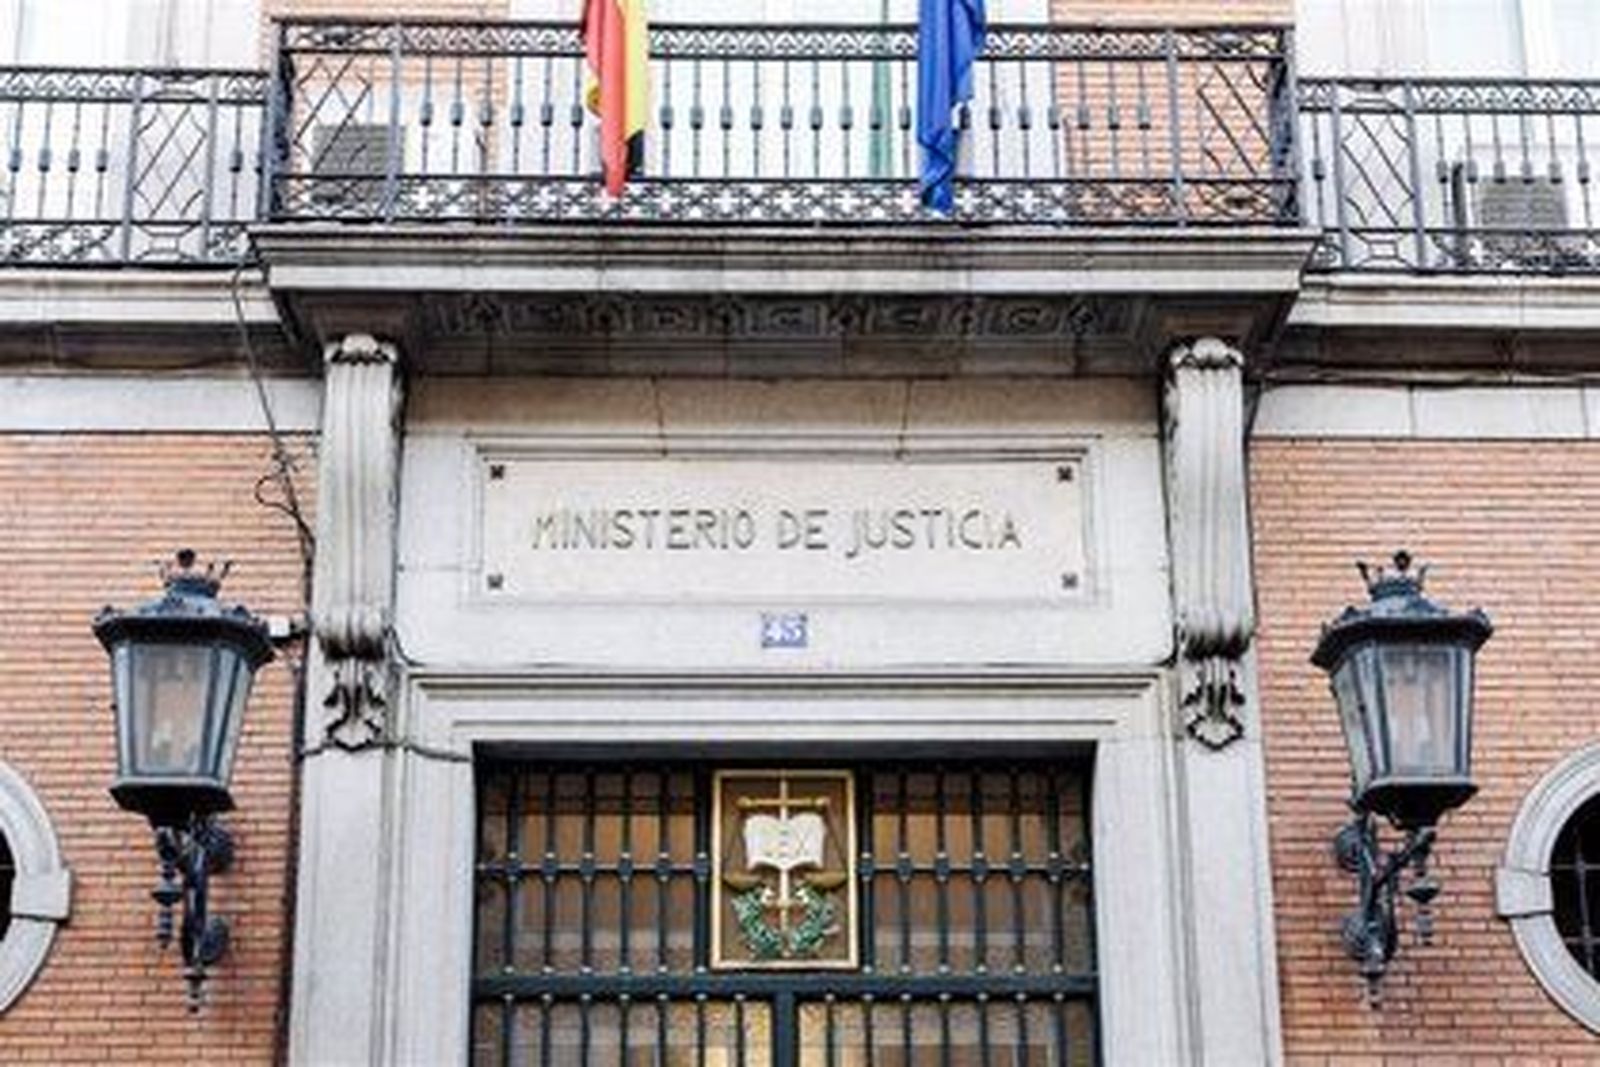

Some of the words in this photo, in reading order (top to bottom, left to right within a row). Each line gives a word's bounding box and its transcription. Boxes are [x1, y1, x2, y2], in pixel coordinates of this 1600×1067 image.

[532, 509, 755, 551] MINISTERIO
[777, 509, 829, 551] DE
[845, 509, 1023, 559] JUSTICIA
